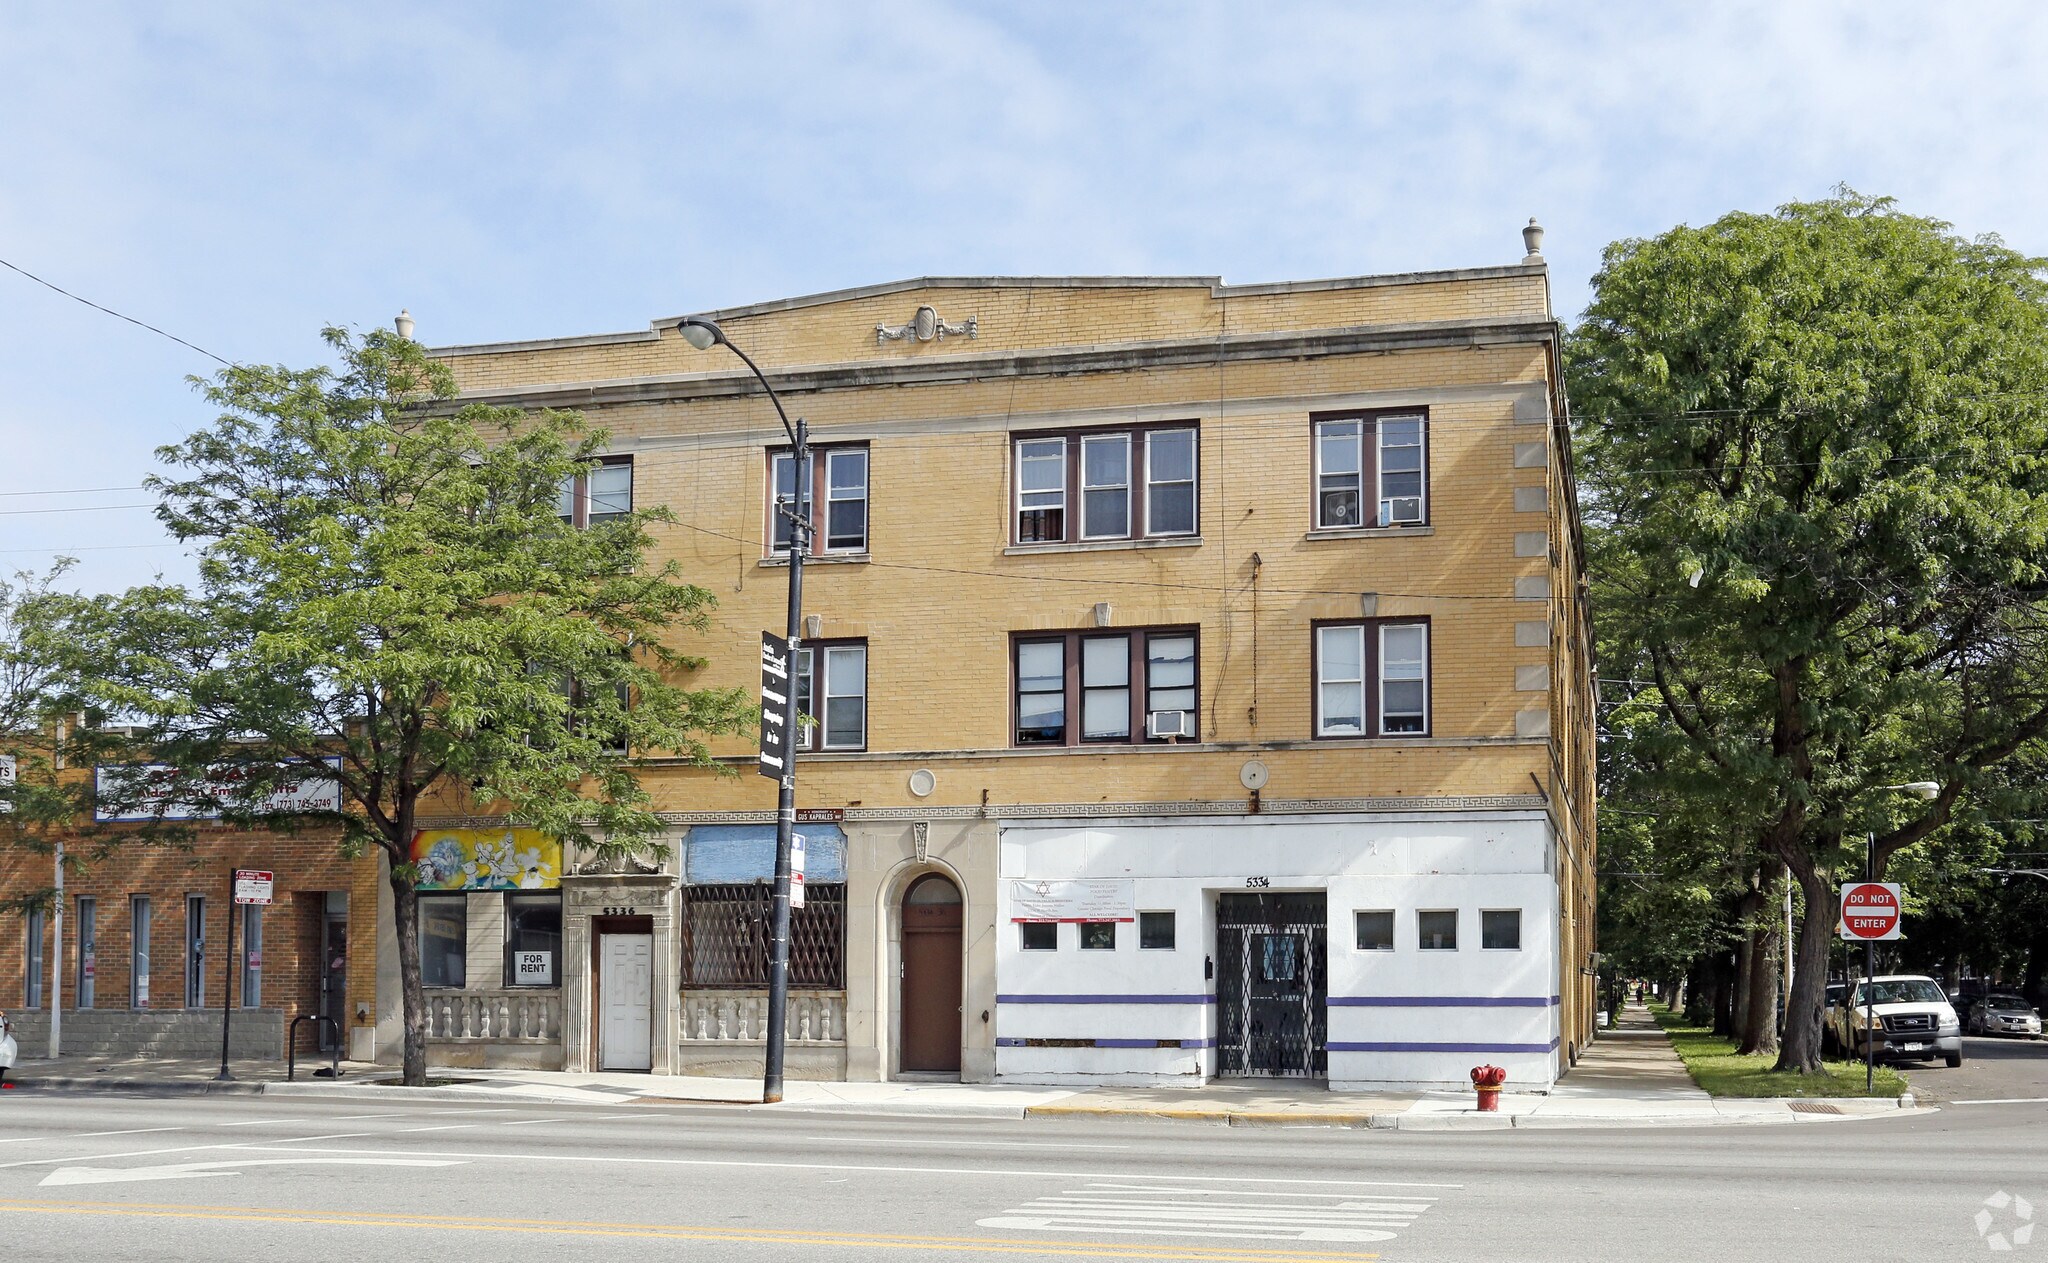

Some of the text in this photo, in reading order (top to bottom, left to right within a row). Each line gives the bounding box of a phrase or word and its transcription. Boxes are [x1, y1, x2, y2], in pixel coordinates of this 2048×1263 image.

[276, 800, 295, 811] (773)
[1246, 876, 1270, 888] 5334
[1850, 894, 1890, 903] DO NOT
[603, 907, 635, 916] 5336
[1853, 918, 1886, 928] ENTER
[523, 954, 543, 963] FOR
[520, 963, 546, 973] RENT
